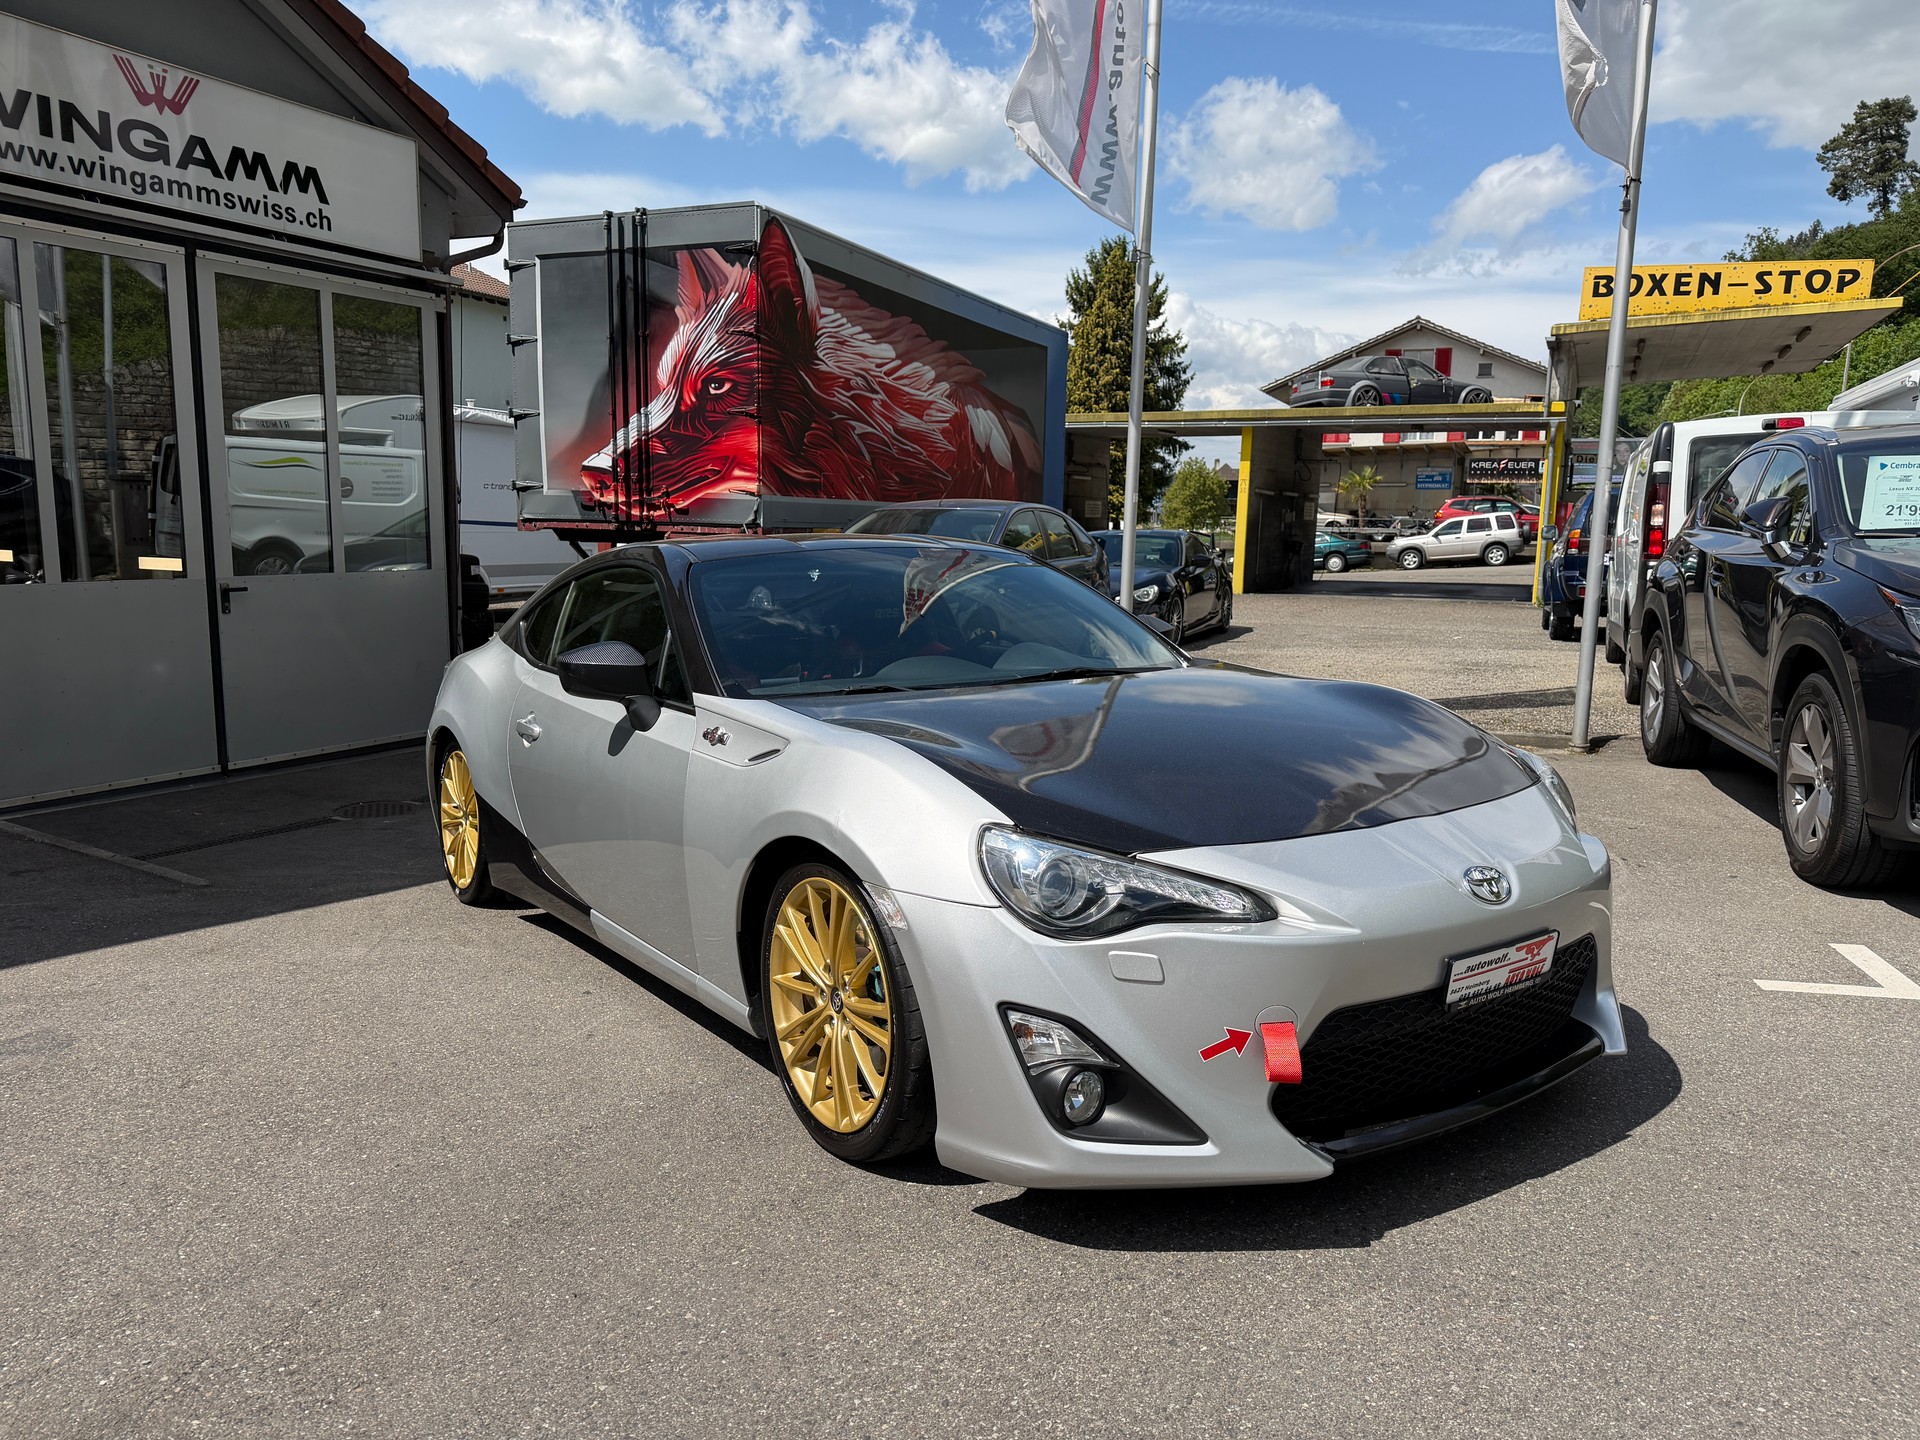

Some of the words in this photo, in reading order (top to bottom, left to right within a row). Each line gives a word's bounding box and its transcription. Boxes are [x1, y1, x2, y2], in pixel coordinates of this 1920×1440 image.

[1885, 504, 1920, 517] 21'9
[1469, 996, 1487, 1005] AUTO
[1488, 989, 1505, 999] WOLF
